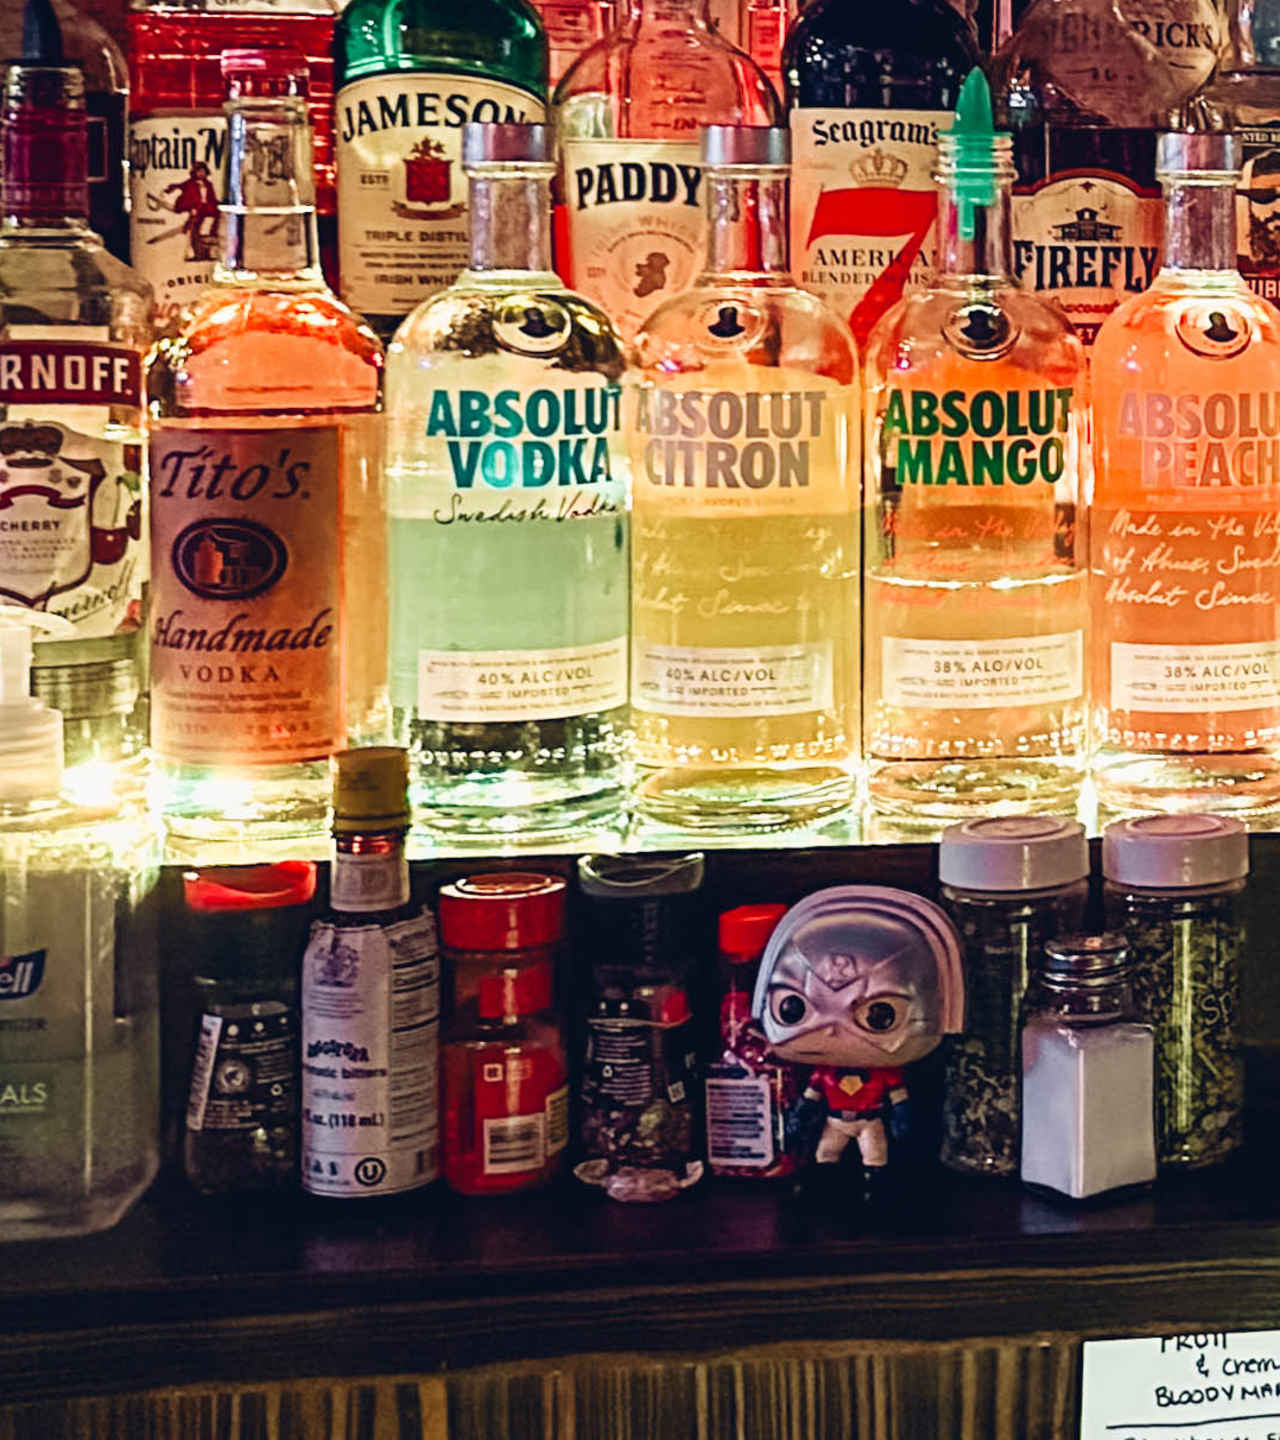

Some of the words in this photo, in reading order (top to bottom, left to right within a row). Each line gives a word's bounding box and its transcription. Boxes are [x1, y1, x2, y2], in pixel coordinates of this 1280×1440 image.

[812, 118, 942, 149] Seagram's
[576, 162, 700, 210] PADDY
[365, 231, 412, 242] TRIPLE
[807, 185, 940, 347] 7
[1013, 240, 1159, 293] FIREFLY
[426, 384, 621, 437] ABSOLUT
[636, 391, 825, 438] ABSOLUT
[889, 388, 1073, 438] ABSOLUT
[159, 445, 309, 502] Tito's
[448, 437, 613, 488] VODKA
[645, 440, 810, 488] CITRON
[896, 439, 1064, 486] MANGO
[1142, 441, 1279, 486] PEACH
[434, 492, 549, 525] Swedish
[1111, 510, 1162, 536] Made
[154, 608, 333, 653] Handmade
[178, 664, 280, 683] VODKA
[478, 673, 514, 685] 40%
[666, 670, 694, 681] 40%
[701, 669, 776, 682] ALC/VOL
[934, 661, 966, 673] 38%
[972, 658, 1042, 672] ALC/VOL
[1164, 666, 1196, 679] 38%
[1202, 663, 1269, 677] ALC/VOL
